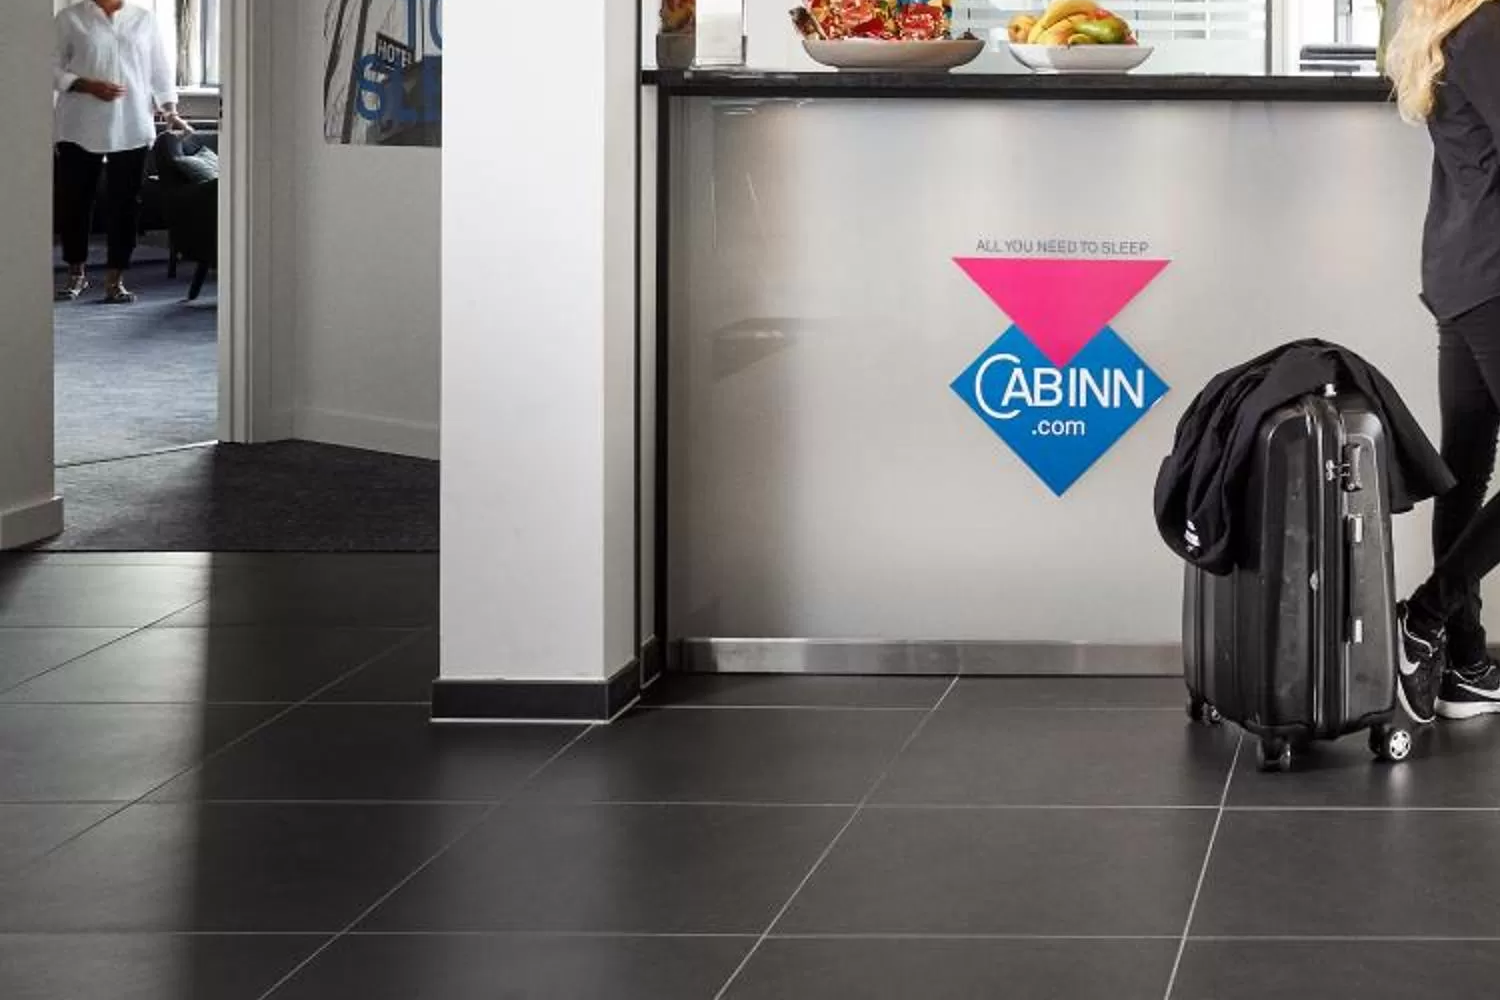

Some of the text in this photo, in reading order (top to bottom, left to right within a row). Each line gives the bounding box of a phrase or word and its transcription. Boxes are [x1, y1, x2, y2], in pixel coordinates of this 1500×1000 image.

[976, 239, 1149, 256] ALL YOU NEED TO SLEEP
[975, 353, 1145, 420] CABINN
[1031, 420, 1086, 436] .com
